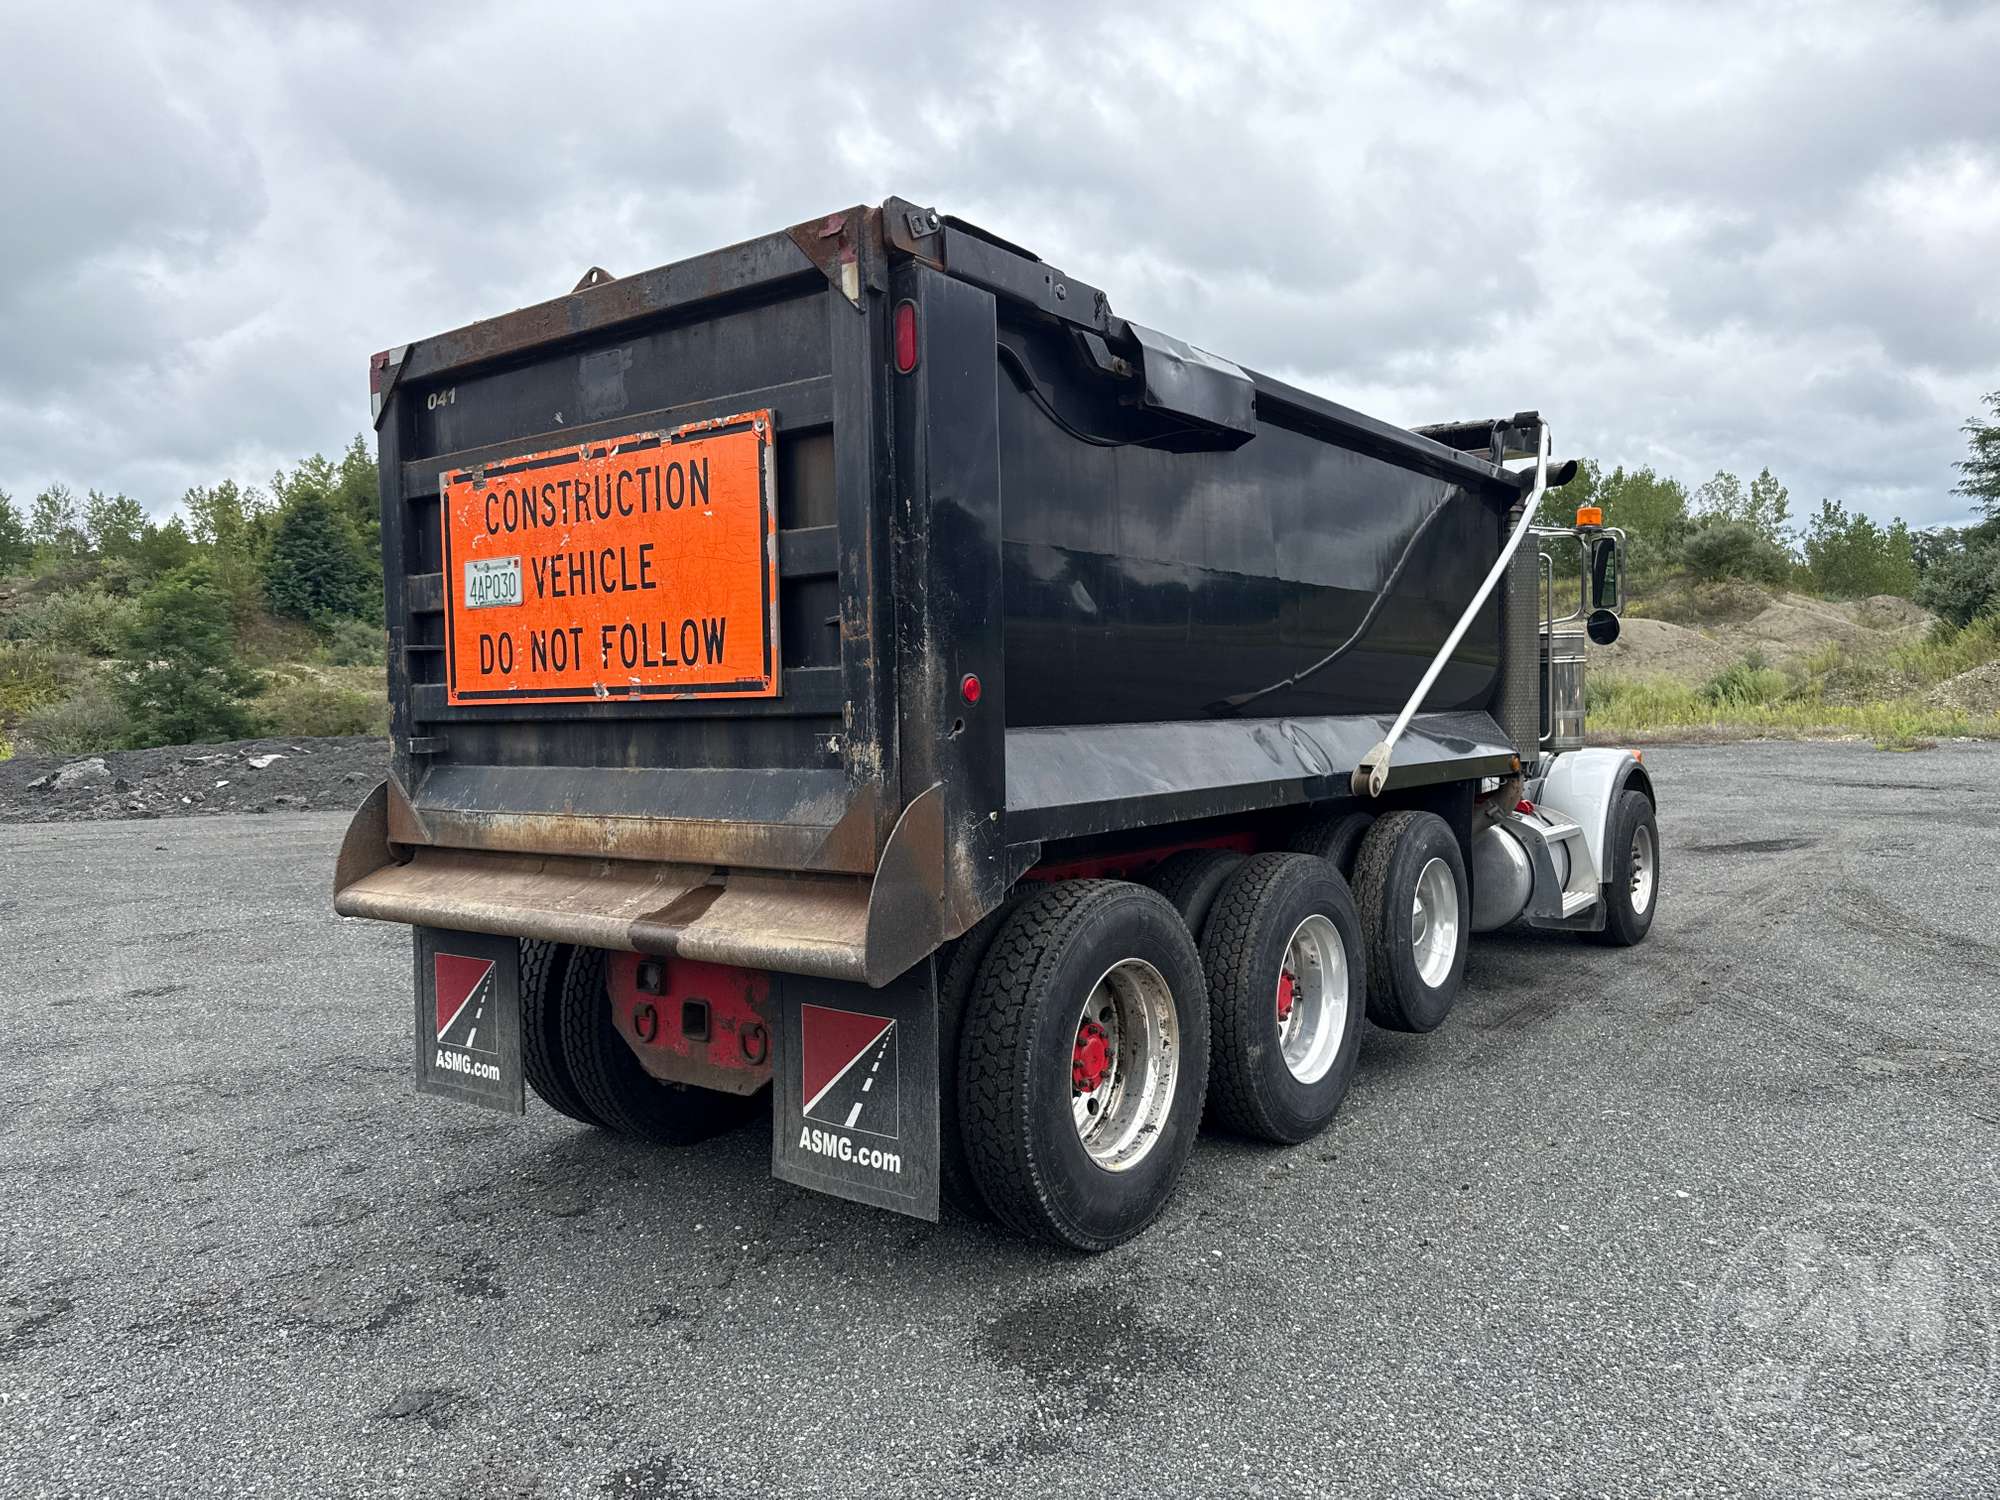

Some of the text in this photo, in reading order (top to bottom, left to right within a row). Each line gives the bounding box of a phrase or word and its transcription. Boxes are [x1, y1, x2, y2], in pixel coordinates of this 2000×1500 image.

[427, 387, 456, 410] 041
[485, 457, 711, 536] CONSTRUCTION
[532, 543, 656, 599] VEHICLE
[480, 617, 727, 675] DO NOT FOLLOW
[435, 1049, 500, 1081] ASMG.com
[799, 1126, 902, 1174] ASMG.com
